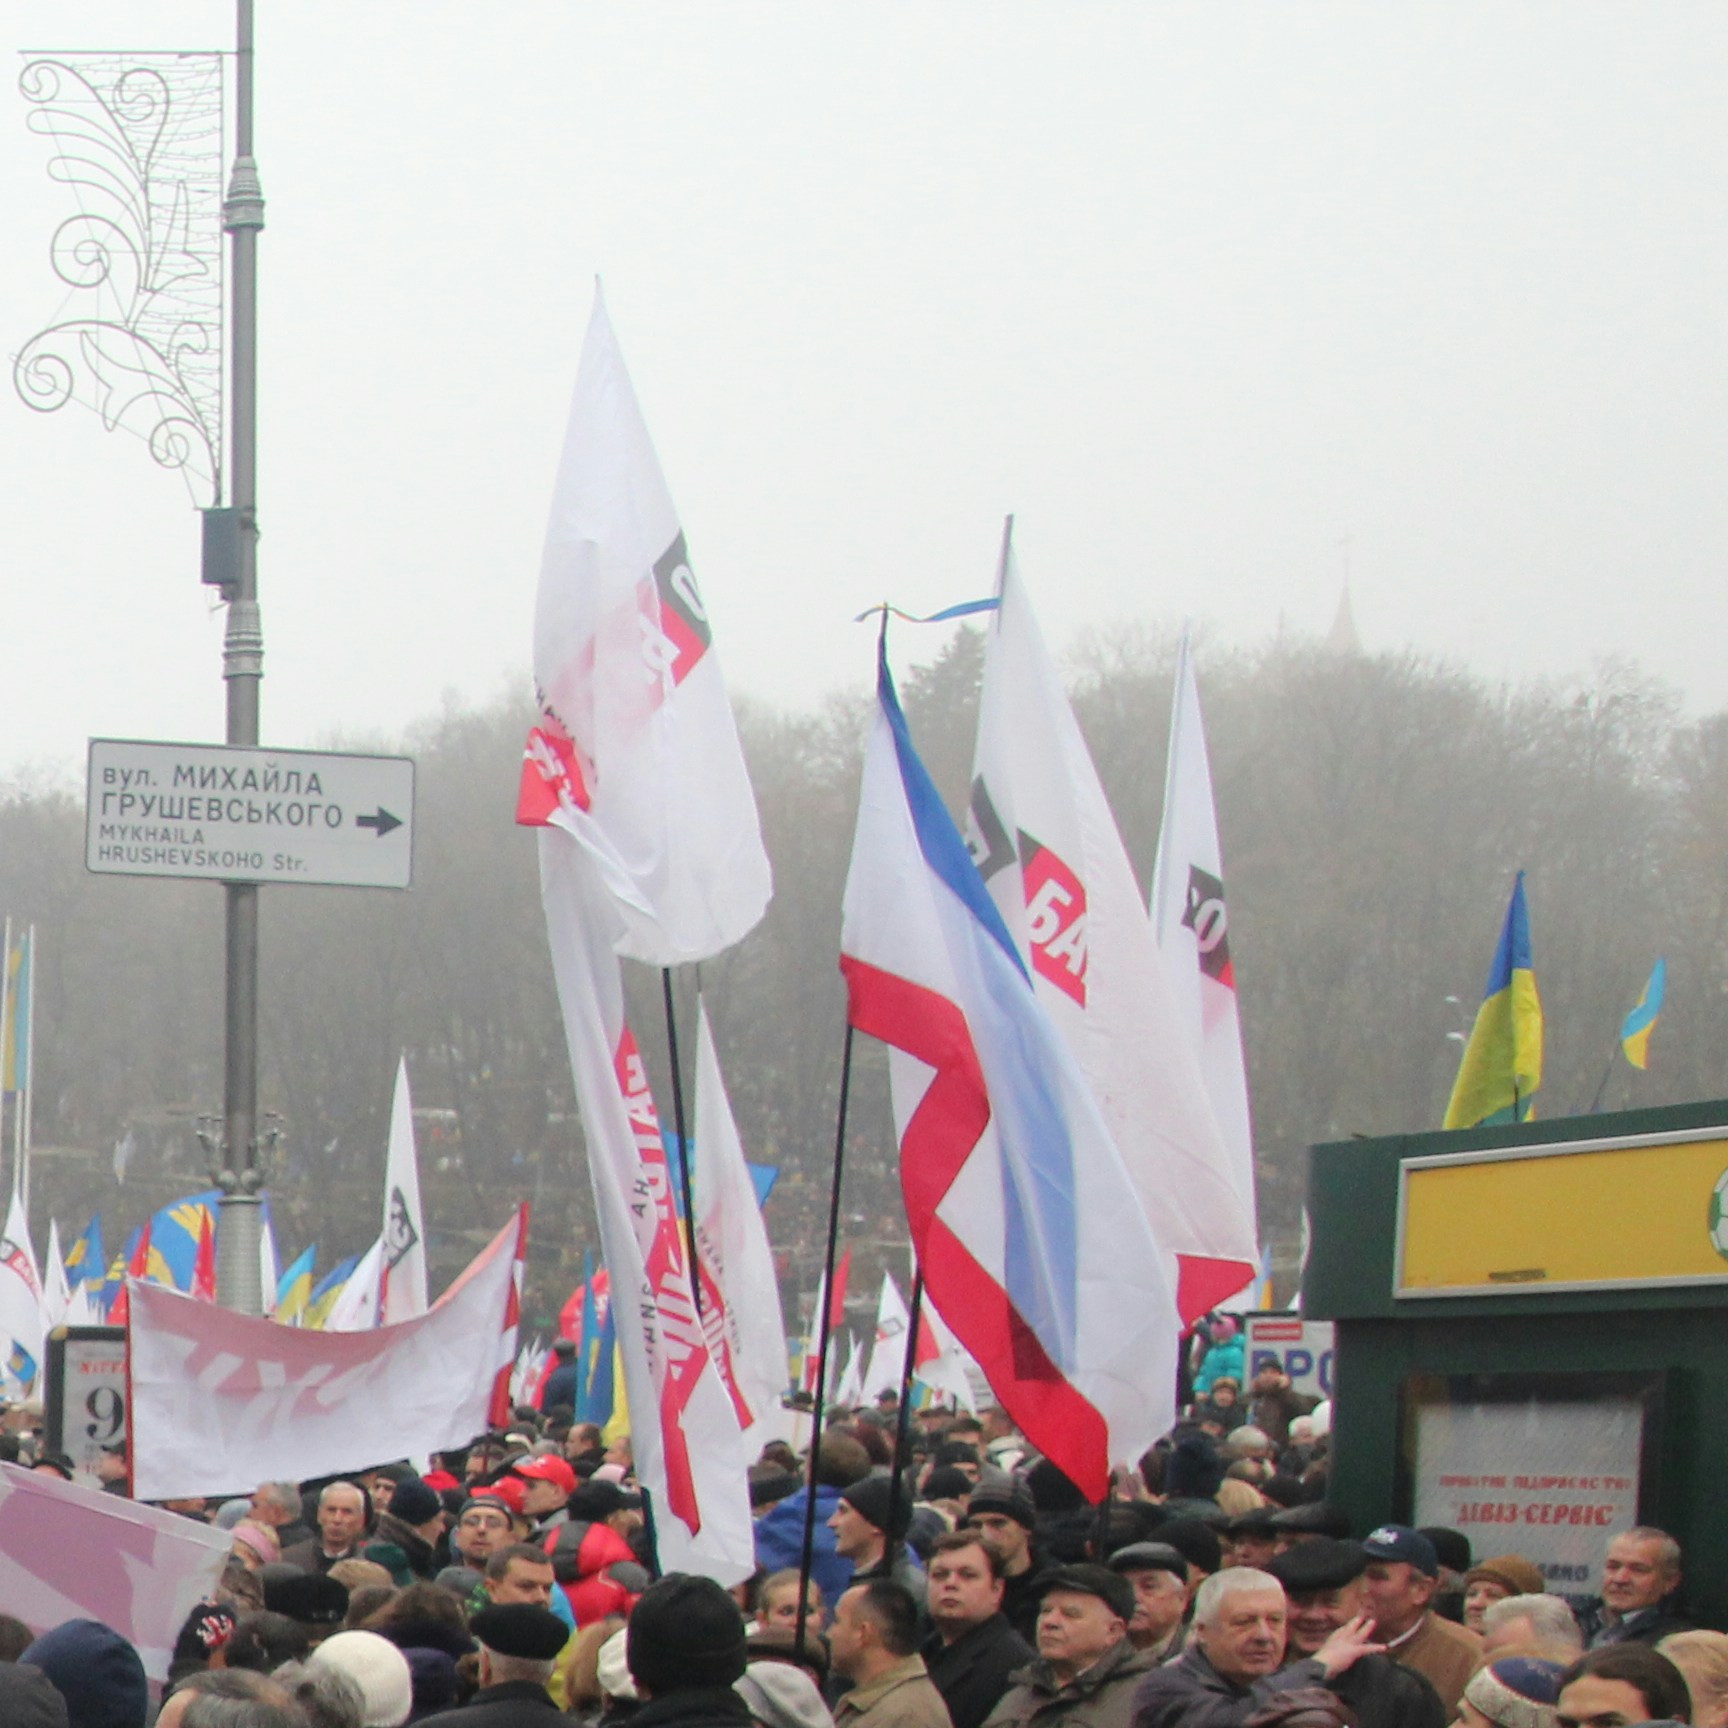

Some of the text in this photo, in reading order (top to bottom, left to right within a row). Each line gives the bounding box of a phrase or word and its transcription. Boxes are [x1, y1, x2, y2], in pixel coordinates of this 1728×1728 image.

[103, 762, 324, 796] вул. МИХАЙЛА
[101, 792, 343, 829] ГРУШЕВСЬКОГО
[99, 824, 205, 845] MYKHAILA
[98, 846, 310, 873] HRUSHEVSKOHO Str.
